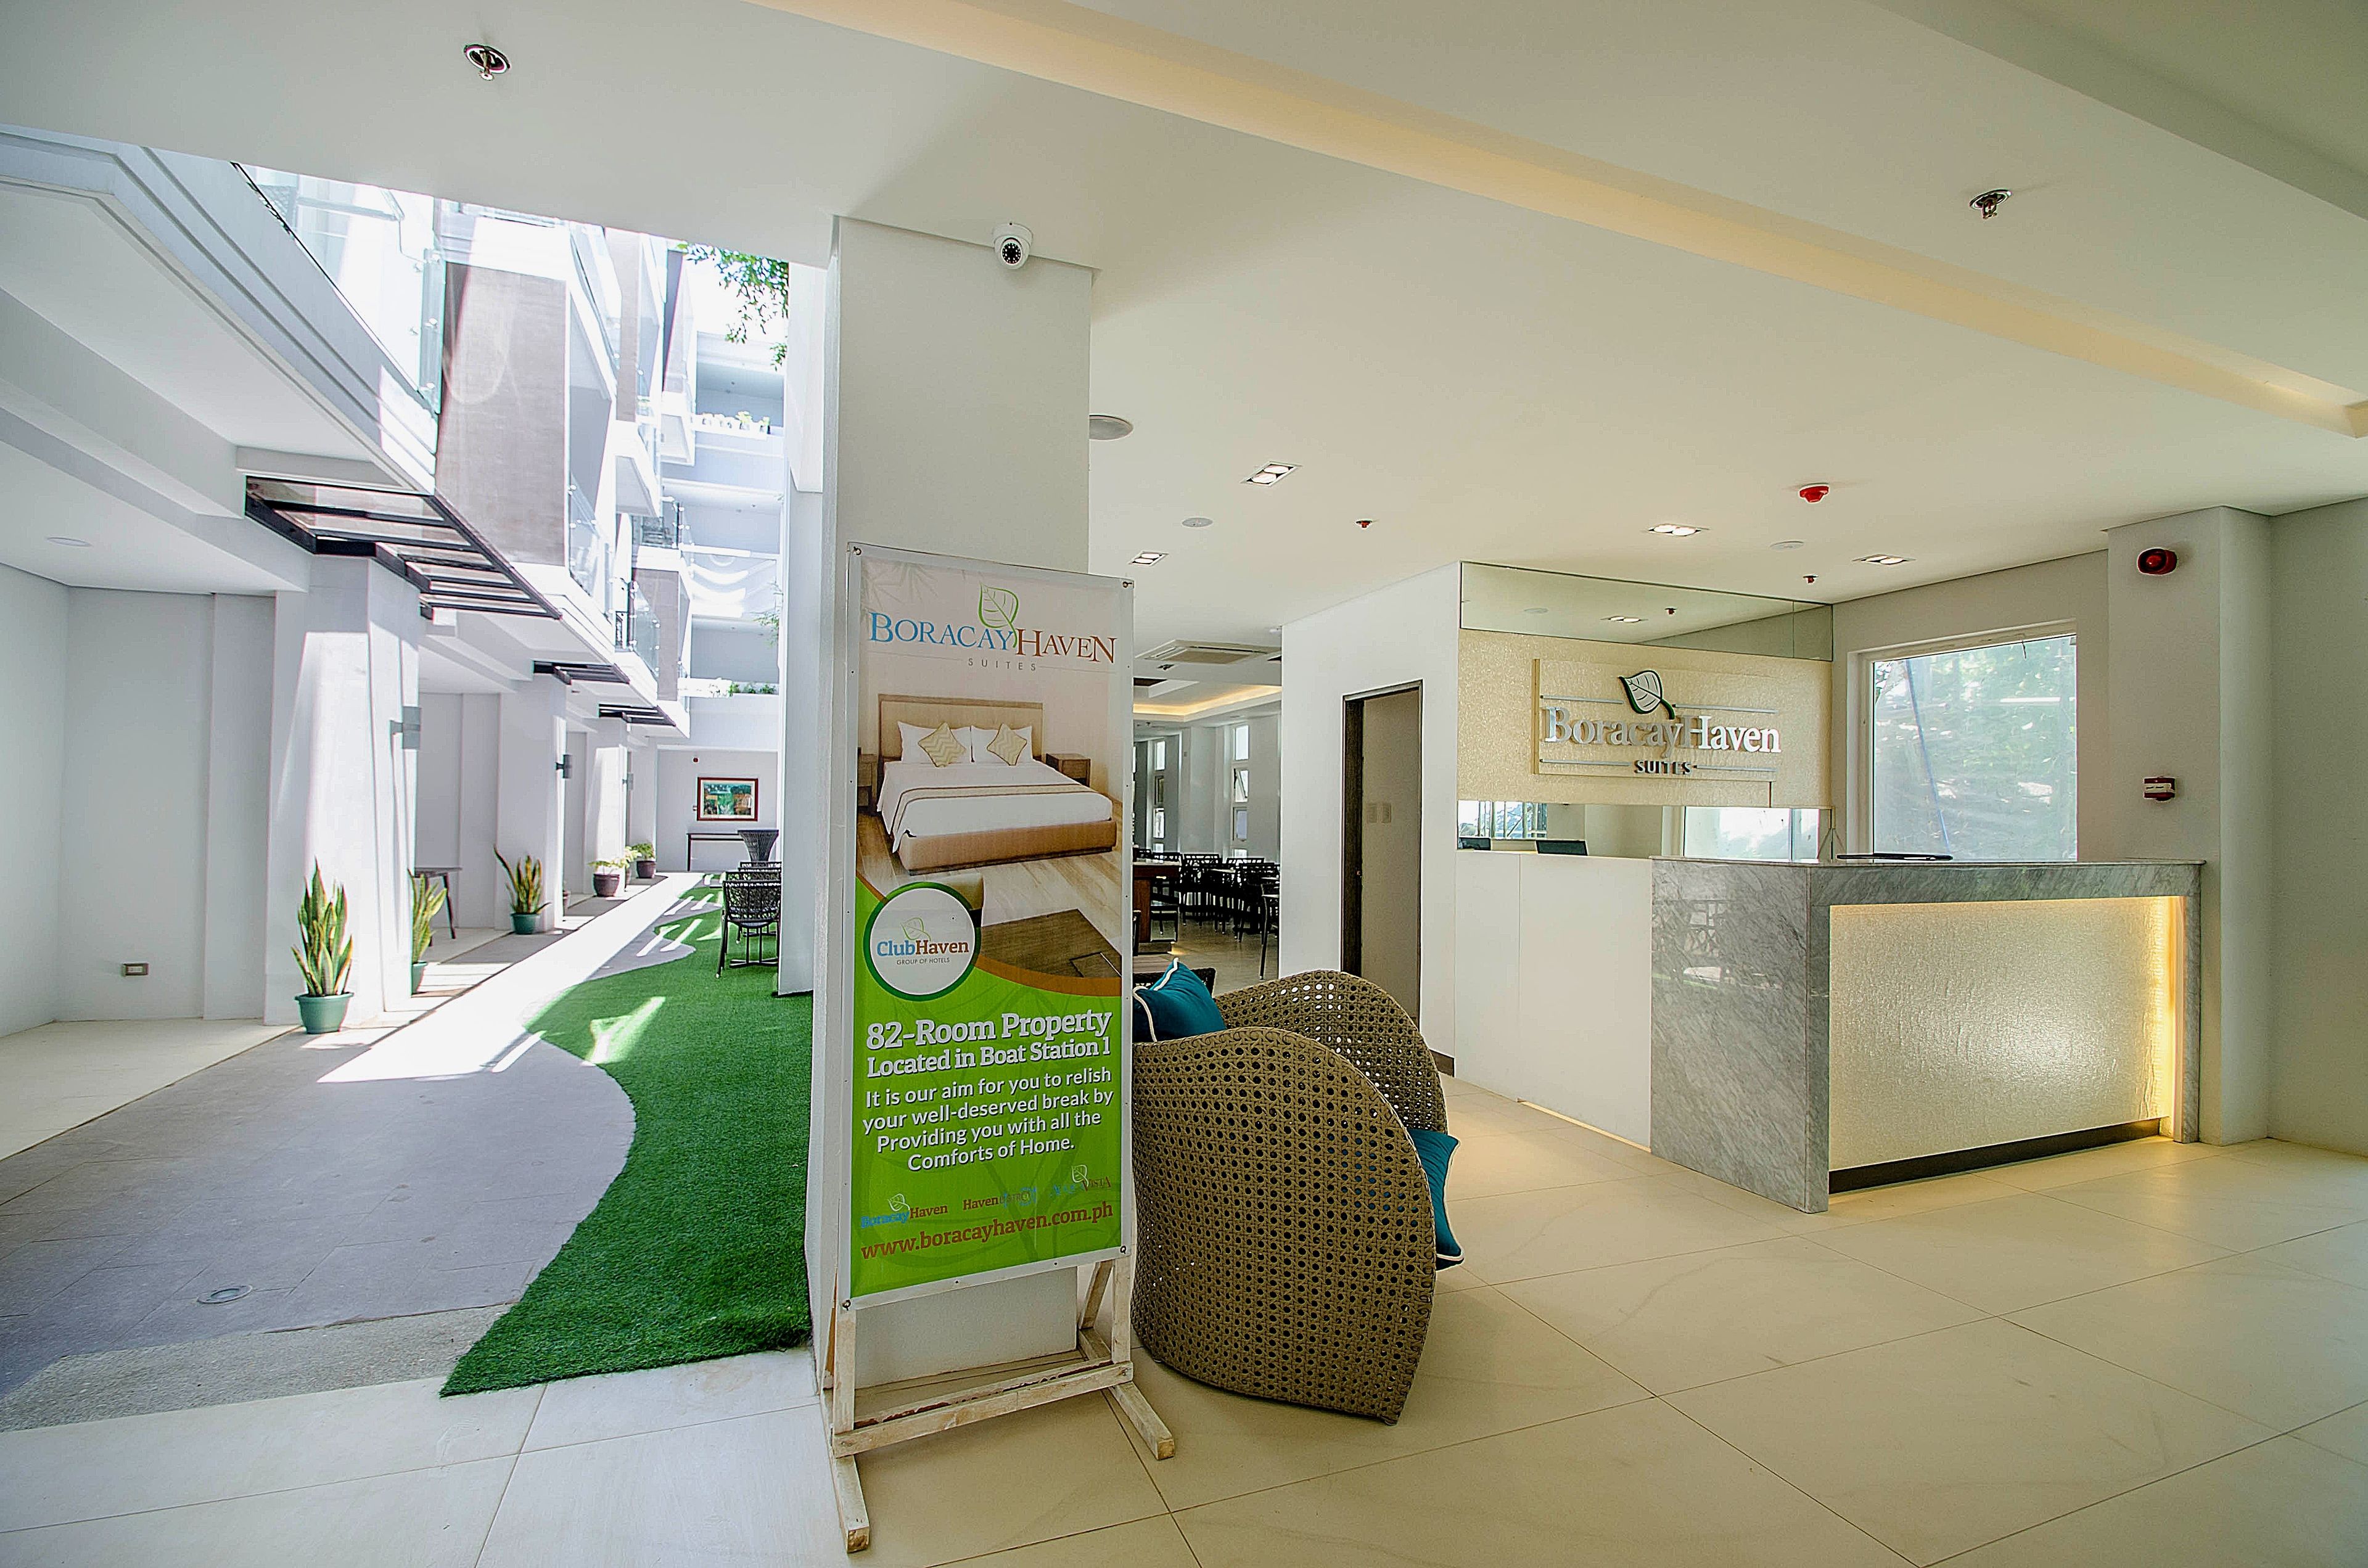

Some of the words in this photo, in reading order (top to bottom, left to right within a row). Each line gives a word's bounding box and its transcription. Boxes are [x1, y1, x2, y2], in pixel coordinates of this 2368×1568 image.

[968, 657, 1037, 671] SUITES
[1634, 759, 1693, 775] SUITES
[866, 1019, 997, 1050] 82-Room
[1001, 1009, 1112, 1041] Property
[867, 1049, 951, 1078] Located
[955, 1048, 976, 1069] in
[980, 1045, 1027, 1065] Boat
[1030, 1039, 1100, 1061] Station
[1102, 1036, 1111, 1056] 1
[866, 1091, 881, 1108] It
[886, 1088, 901, 1106] is
[905, 1087, 937, 1104] our
[942, 1081, 974, 1099] aim
[978, 1078, 1005, 1095] for
[1009, 1077, 1040, 1095] you
[1044, 1072, 1063, 1088] to
[1066, 1066, 1112, 1086] relish
[862, 1114, 907, 1135] your
[911, 1094, 1038, 1126] well-deserved
[1042, 1089, 1090, 1110] break
[1093, 1088, 1114, 1106] by
[877, 1127, 968, 1153] Providing
[971, 1123, 1003, 1143] you
[1007, 1115, 1047, 1136] with
[1050, 1112, 1071, 1130] all
[1074, 1110, 1102, 1127] the
[907, 1145, 993, 1172] Comforts
[997, 1139, 1016, 1158] of
[1019, 1137, 1075, 1155] Home.
[861, 1201, 1113, 1260] www.boracayhaven.com.ph
